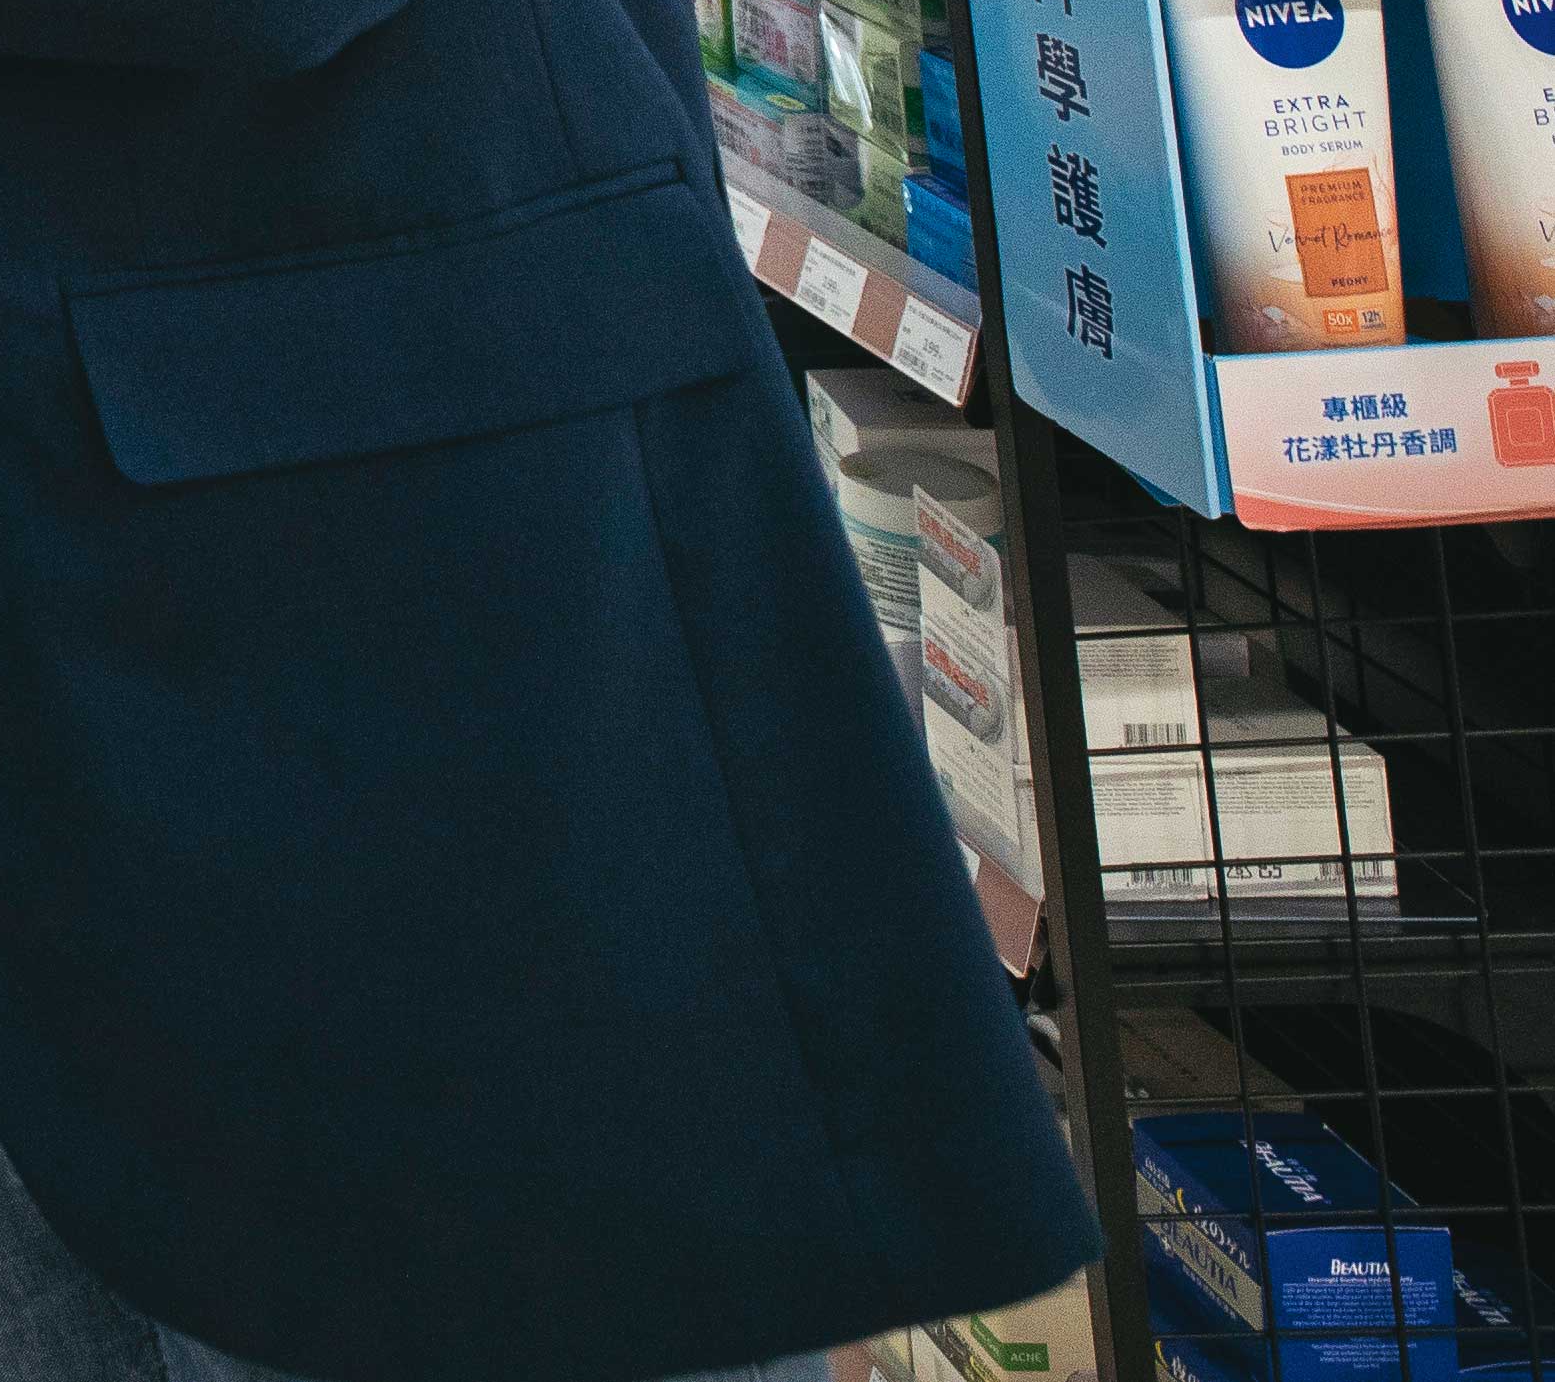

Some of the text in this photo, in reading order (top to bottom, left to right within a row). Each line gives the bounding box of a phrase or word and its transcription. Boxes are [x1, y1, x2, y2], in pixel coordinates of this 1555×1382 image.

[1273, 94, 1350, 115] EXTRA
[1264, 110, 1367, 138] BRIGHT
[1281, 139, 1363, 157] BODY SERUM
[1320, 391, 1410, 421] 專櫃級
[1283, 426, 1459, 463] 花漾牡丹香調
